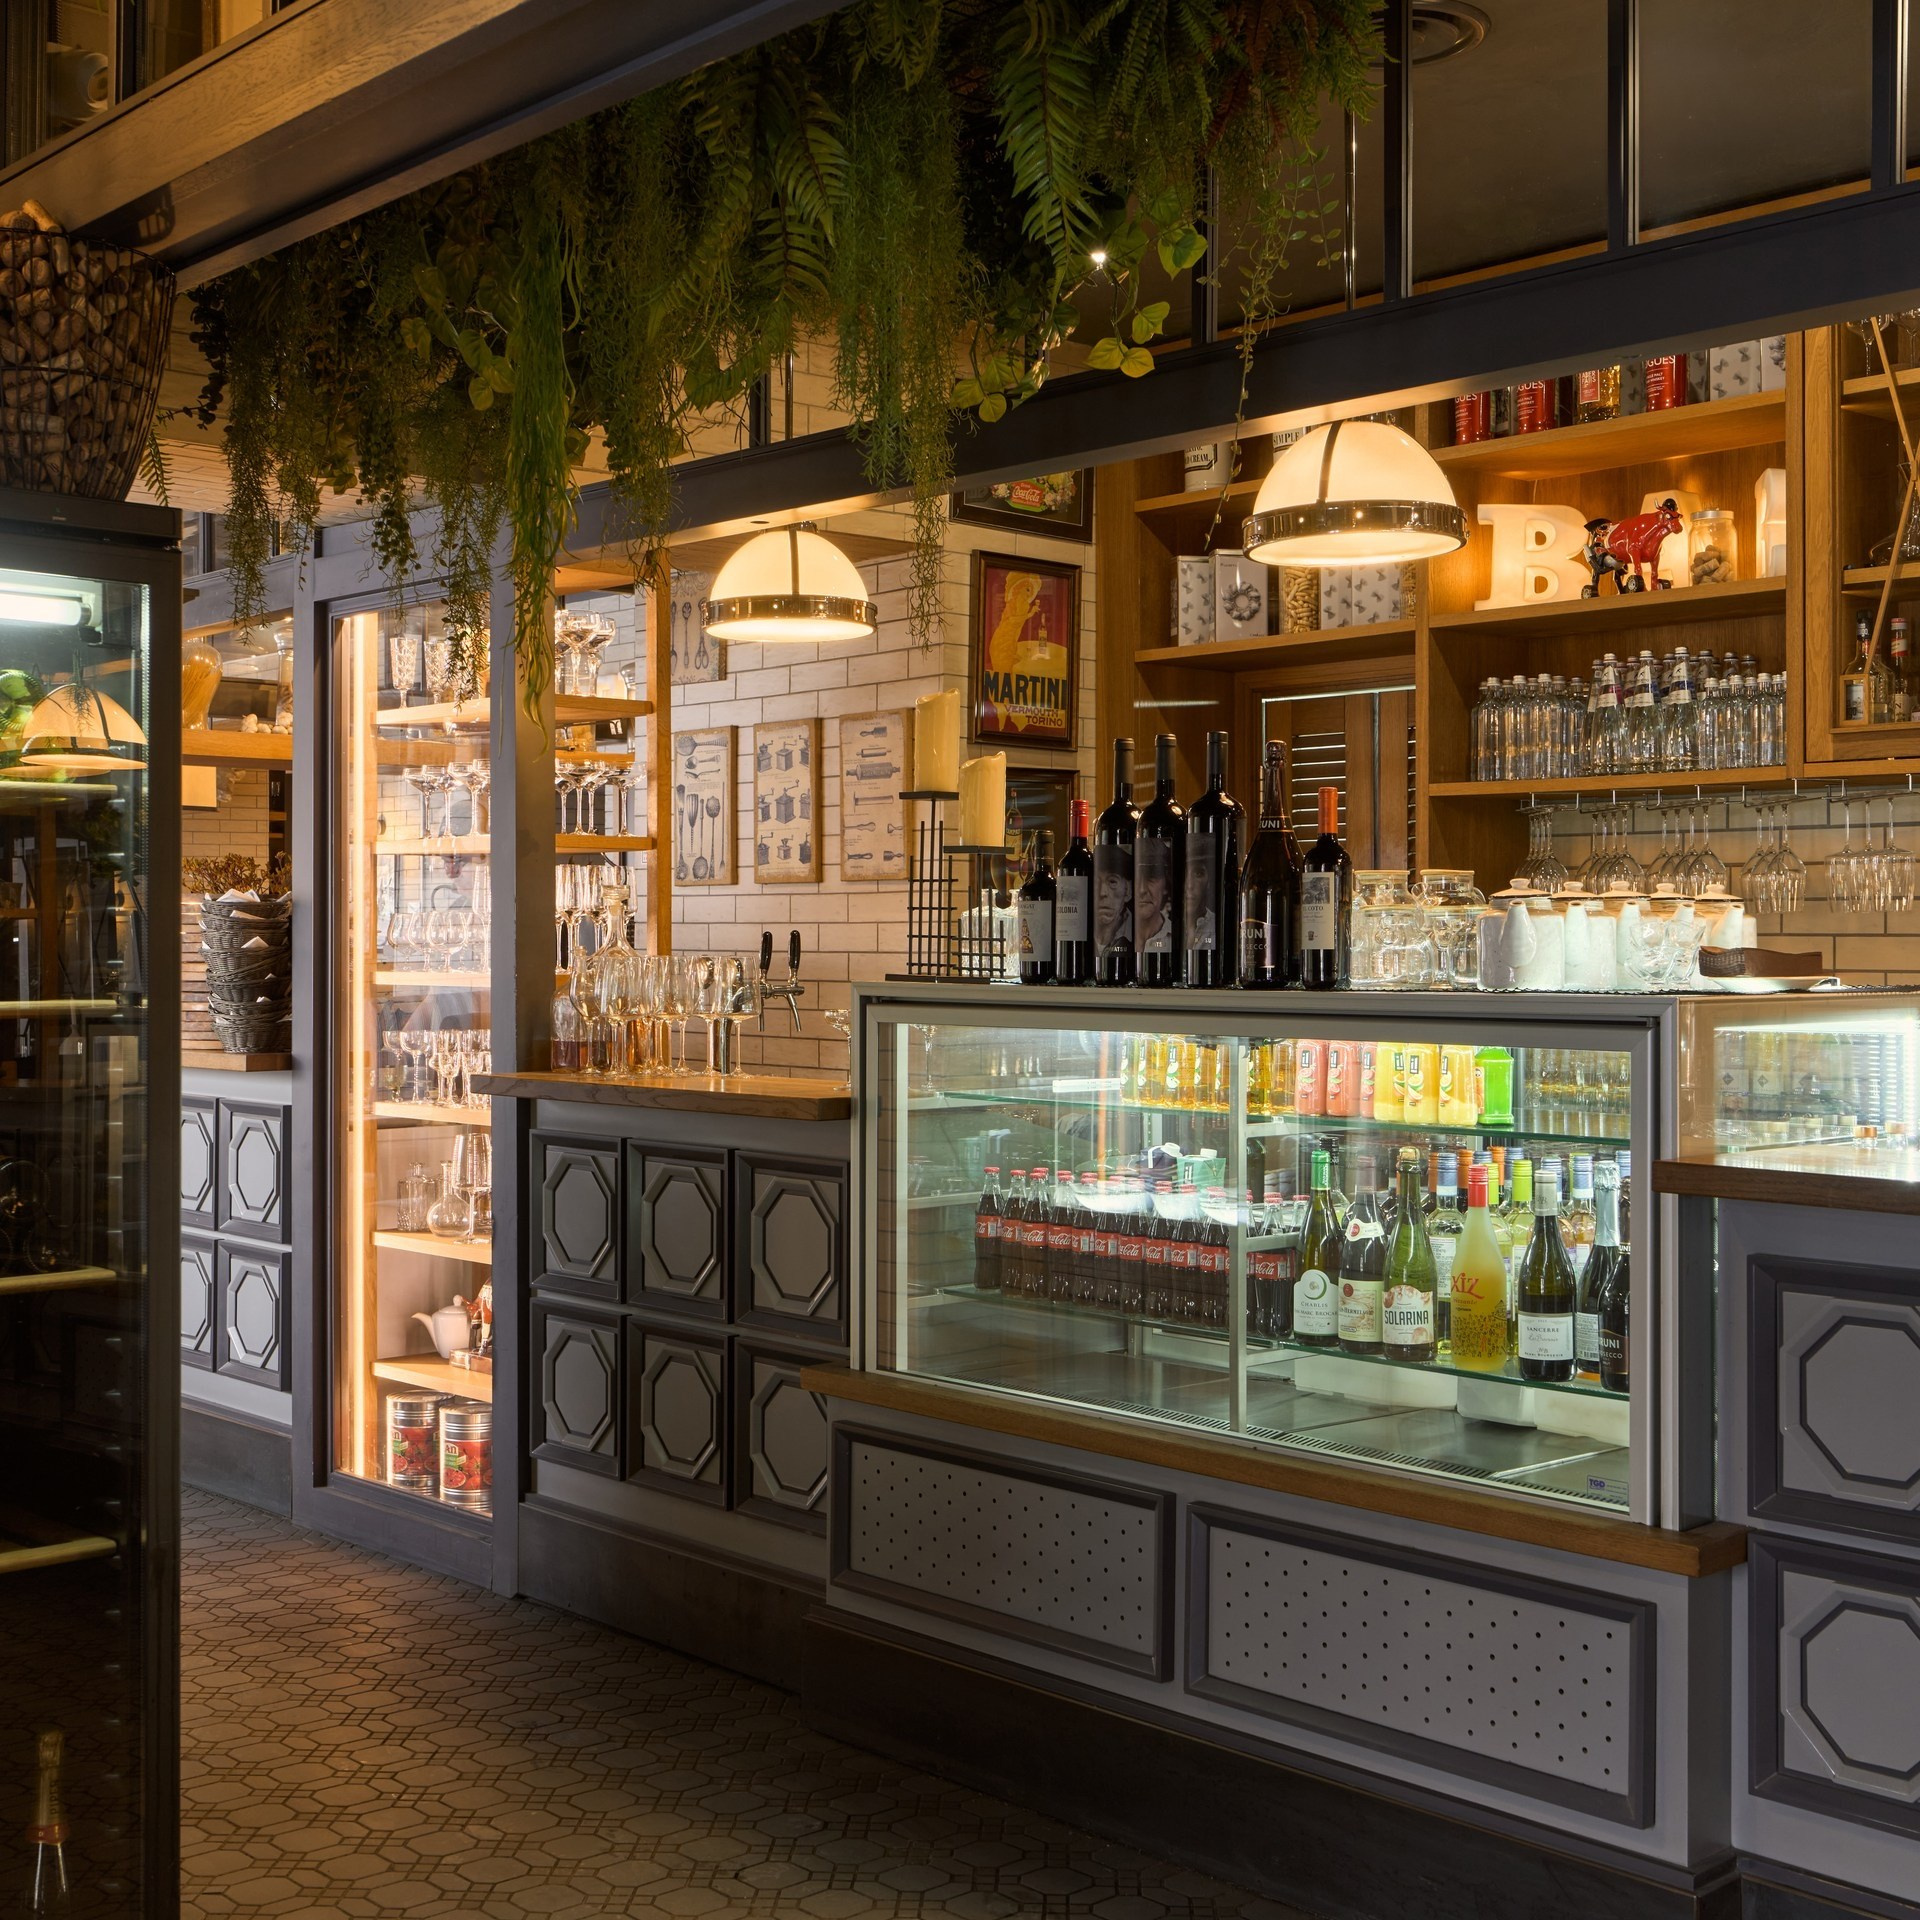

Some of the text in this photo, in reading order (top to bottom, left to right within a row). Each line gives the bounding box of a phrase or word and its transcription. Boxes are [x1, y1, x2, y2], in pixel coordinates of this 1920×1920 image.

[984, 670, 1067, 710] MARTINI
[1004, 703, 1059, 717] VERMOUTH
[1025, 714, 1063, 727] TORINO
[1384, 1310, 1429, 1326] SOLARINA
[1589, 1478, 1605, 1488] TGD
